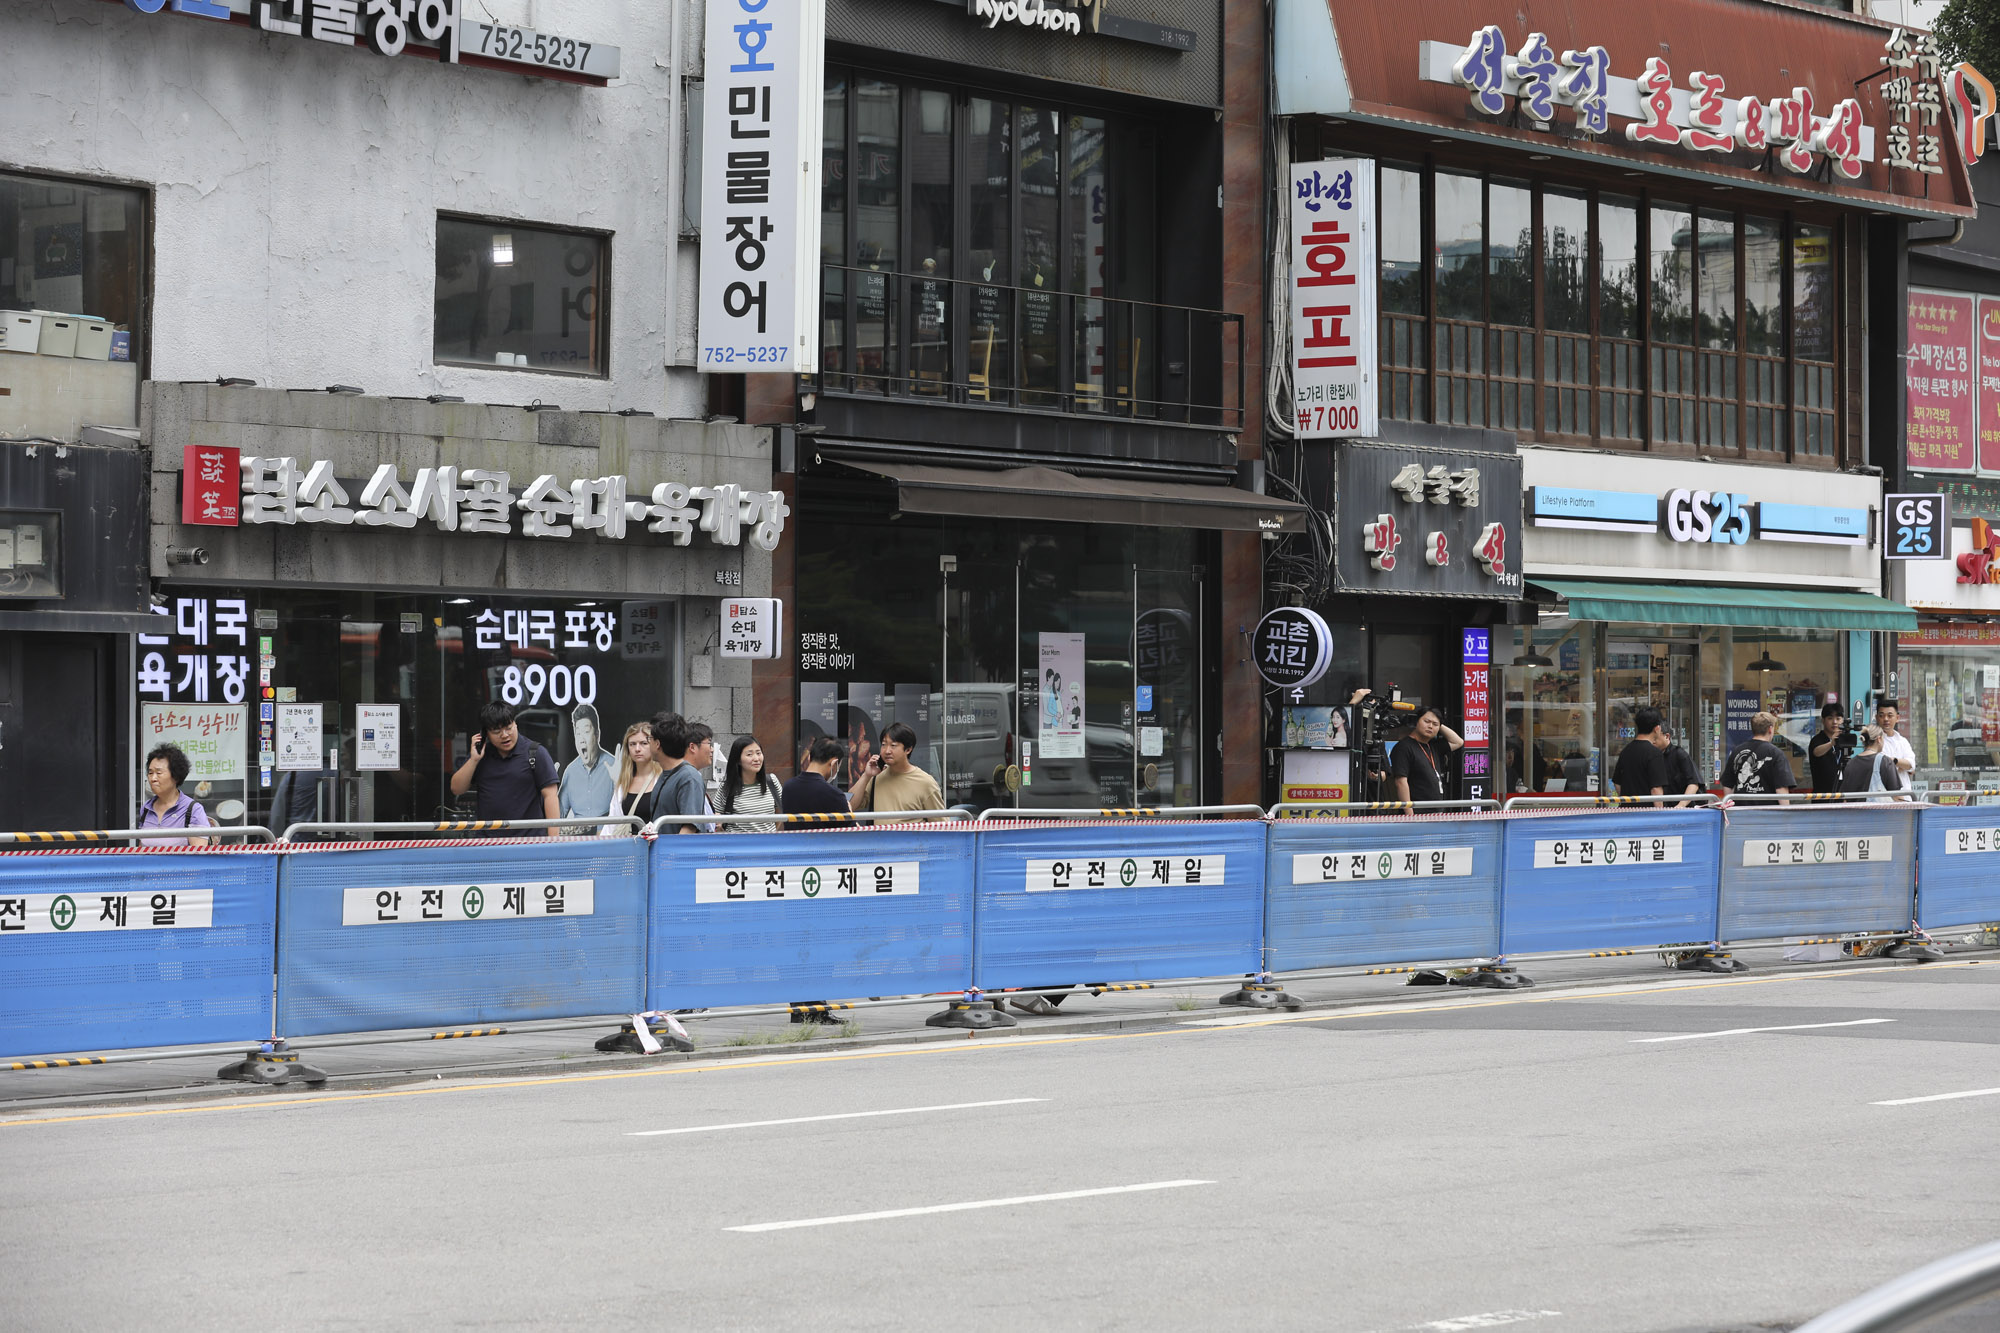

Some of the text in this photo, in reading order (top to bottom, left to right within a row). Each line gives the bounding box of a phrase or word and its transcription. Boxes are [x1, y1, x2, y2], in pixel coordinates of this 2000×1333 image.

[479, 24, 592, 71] 752-5237
[1160, 30, 1190, 47] 318-1992
[1453, 25, 1610, 134] 선술집
[1296, 170, 1353, 212] 만선
[723, 86, 773, 334] 민물장어
[1297, 221, 1356, 368] 호프
[704, 347, 788, 363] 752-5237
[1298, 383, 1357, 402] 노가리 (한접시)
[1542, 495, 1595, 508] Lifestyle Platform
[1896, 500, 1933, 525] GS
[1664, 488, 1751, 546] GS25
[1364, 514, 1401, 571] 만
[1473, 522, 1505, 576] 선
[1897, 527, 1932, 553] 25
[716, 570, 740, 585] 북창점
[740, 606, 757, 615] 담소
[475, 608, 616, 651] 순대국 포장
[731, 621, 756, 633] 순대
[1266, 620, 1309, 643] 교촌
[725, 640, 762, 652] 육개장
[801, 633, 840, 650] 정직한 맛,
[1464, 635, 1488, 656] 호프
[801, 653, 855, 670] 정직한 이야기
[1265, 643, 1307, 666] 치킨
[138, 651, 250, 703] 육개장
[1278, 668, 1304, 676] 318.1992
[1464, 671, 1488, 687] 노가리
[502, 663, 597, 706] 8900
[1466, 691, 1487, 704] 1사라
[1728, 699, 1758, 708] WOWPASS
[150, 711, 192, 733] 담소의
[197, 711, 239, 736] 실수!!!
[954, 714, 976, 725] LAGER
[1620, 727, 1636, 738] GS25
[195, 759, 235, 774] 만들었다!
[1555, 840, 1664, 864] 안전 제일
[1768, 840, 1869, 864] 안전 제일
[1959, 832, 1985, 850] 안전
[1053, 859, 1201, 887] 안전 제일
[1322, 852, 1445, 882] 안전 제일
[726, 866, 892, 898] 안전 제일
[100, 895, 175, 926] 제일
[377, 885, 564, 922] 안전 제일
